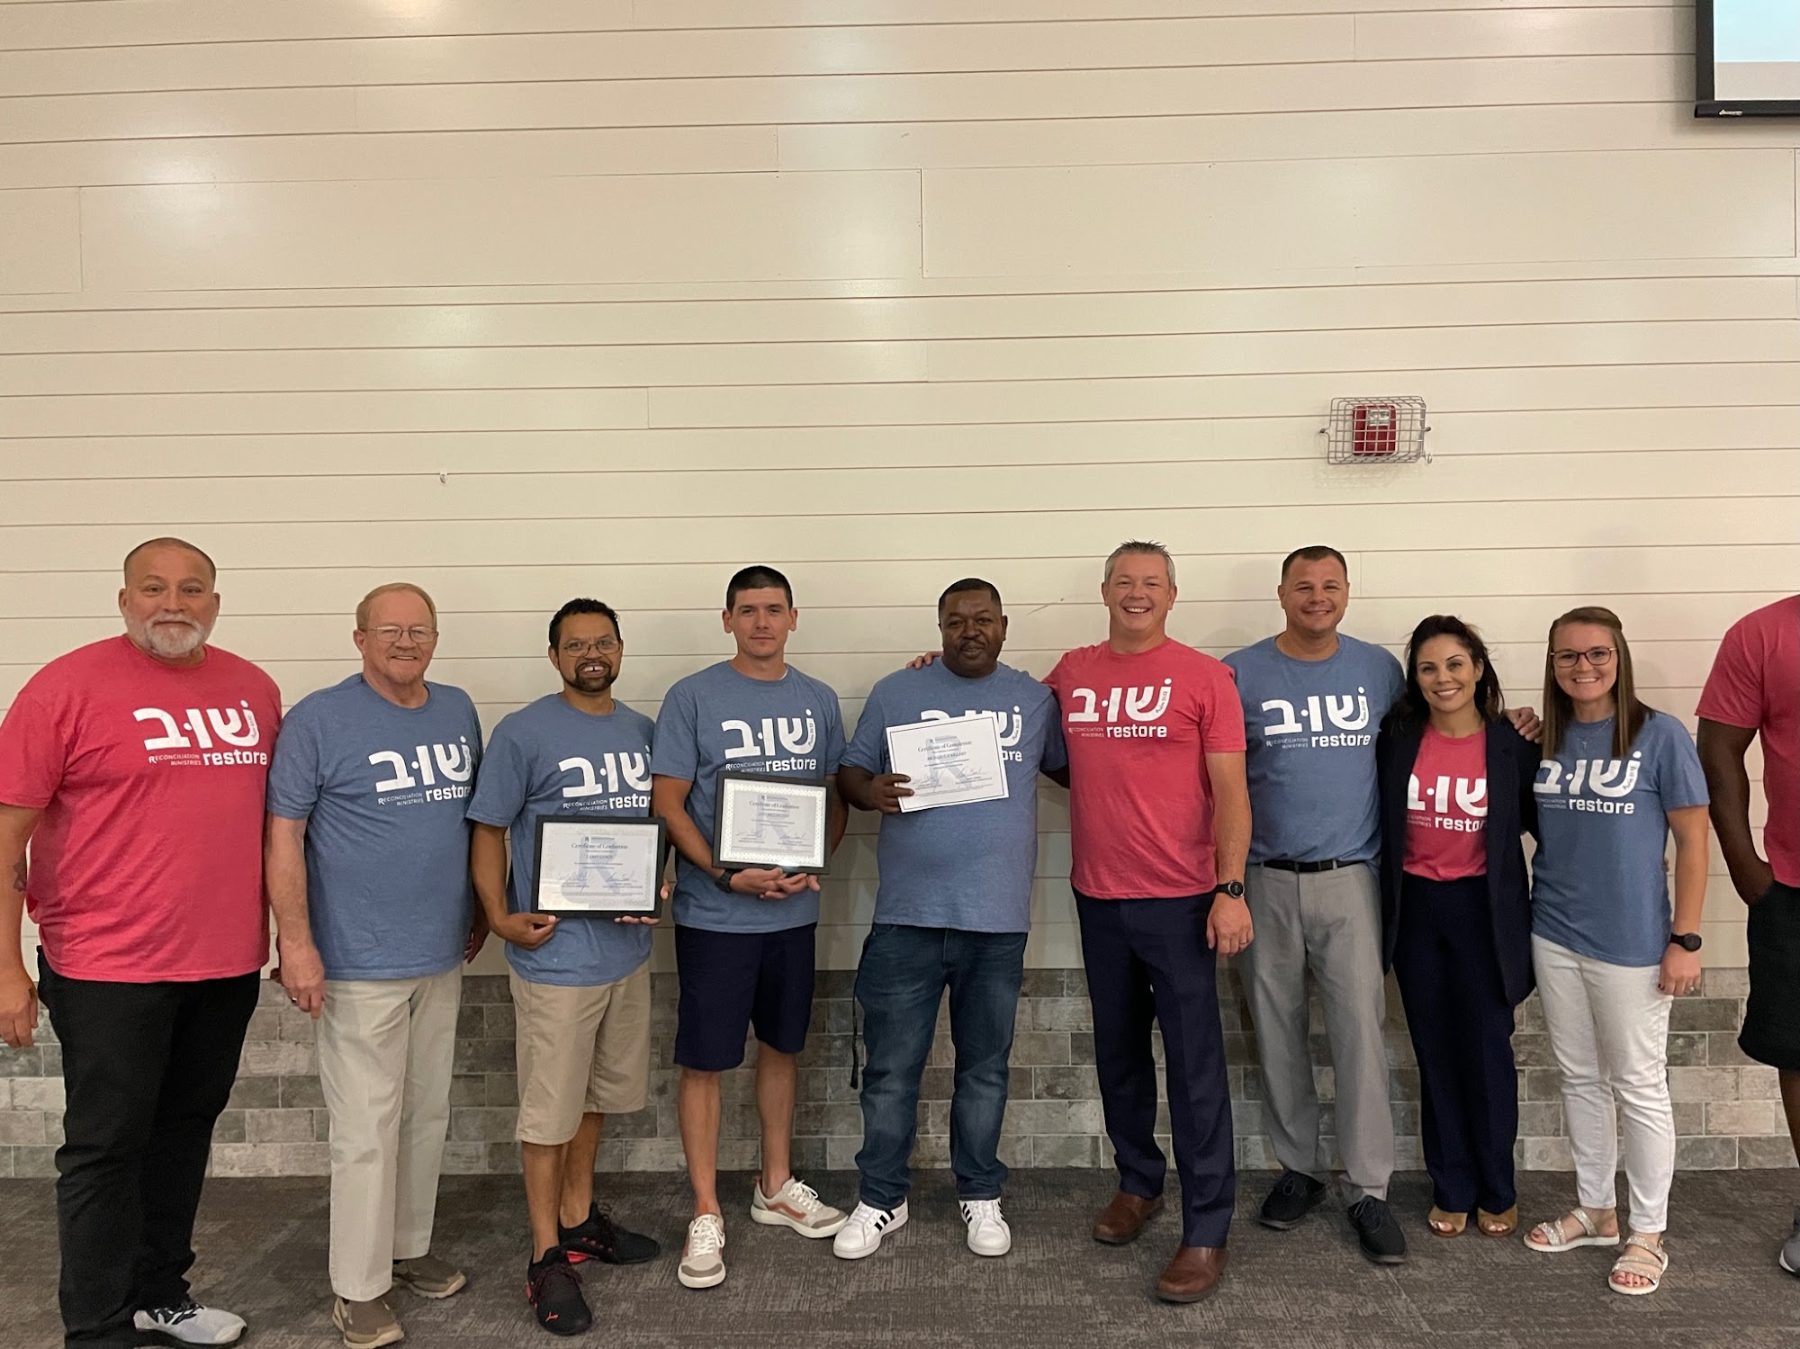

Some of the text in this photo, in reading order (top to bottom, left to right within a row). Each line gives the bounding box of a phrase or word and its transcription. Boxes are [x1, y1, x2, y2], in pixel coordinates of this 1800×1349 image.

[1106, 724, 1167, 738] restore
[1311, 733, 1371, 748] restore
[202, 749, 267, 766] restore
[765, 756, 817, 772] restore
[1569, 798, 1635, 814] restore
